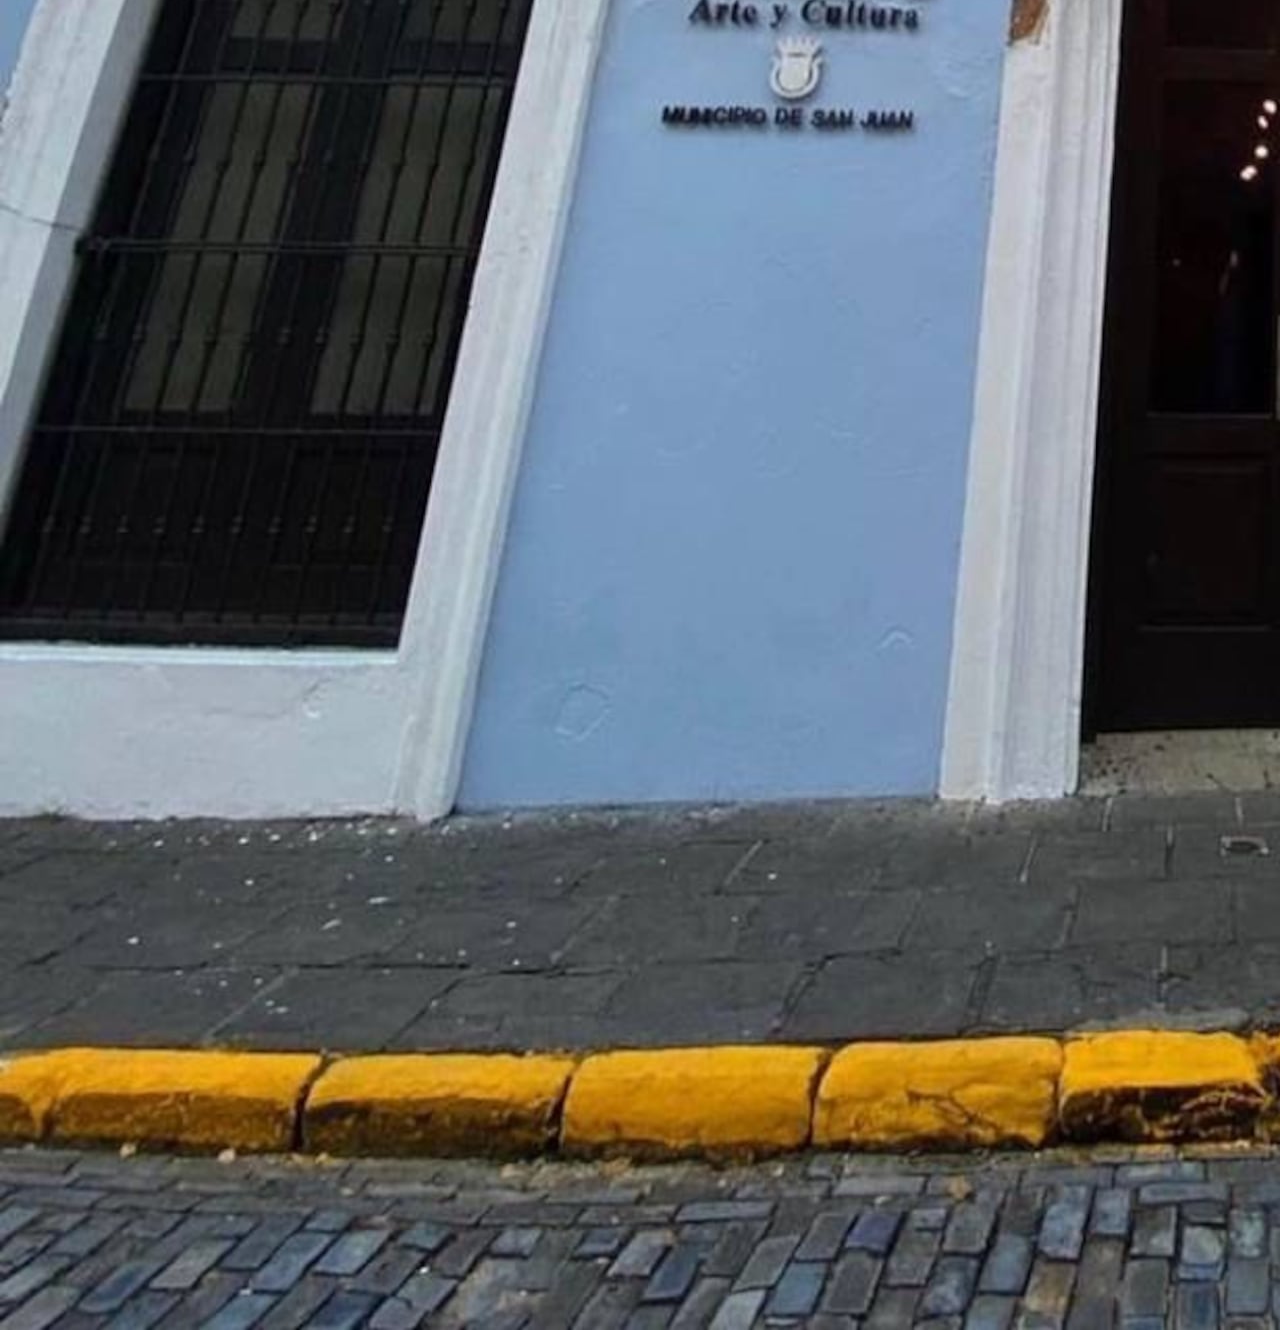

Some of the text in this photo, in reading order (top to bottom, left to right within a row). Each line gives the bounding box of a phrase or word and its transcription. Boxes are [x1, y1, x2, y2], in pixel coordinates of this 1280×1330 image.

[769, 2, 788, 28] y
[661, 105, 915, 130] MUNICIPIO DE SAN JUAN
